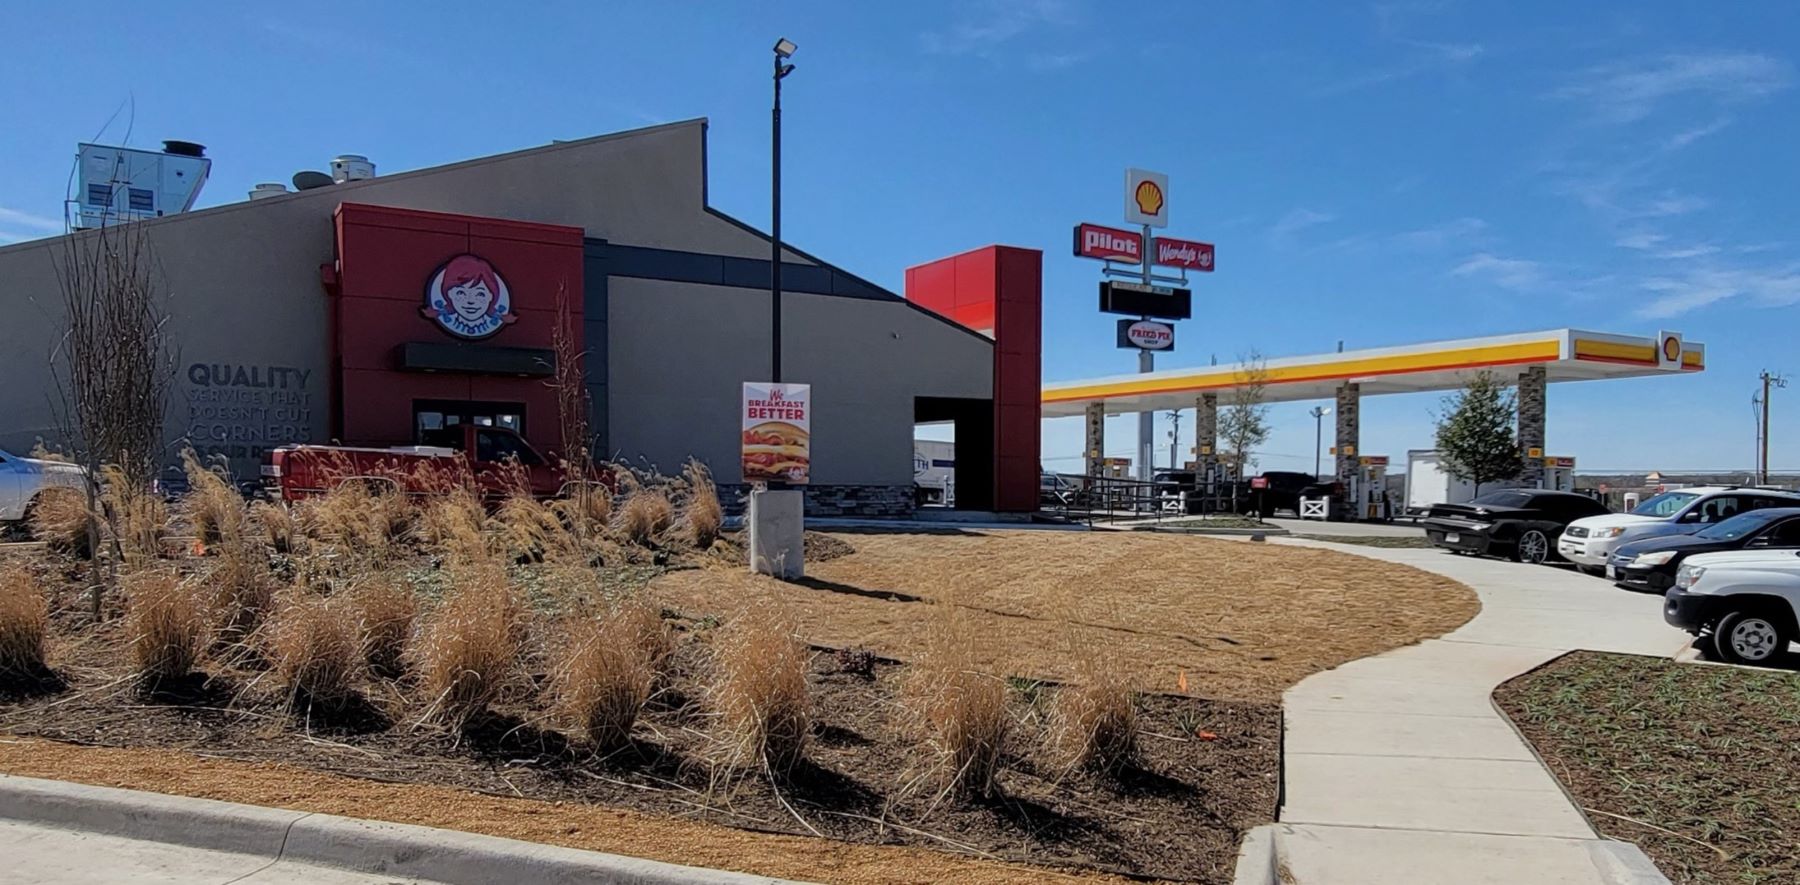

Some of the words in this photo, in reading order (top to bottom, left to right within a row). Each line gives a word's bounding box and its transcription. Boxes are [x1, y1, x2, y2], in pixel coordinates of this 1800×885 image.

[188, 363, 311, 389] QUALITY
[189, 388, 263, 405] SERVICE
[268, 390, 312, 406] THAT
[748, 400, 805, 408] BREAKFAST
[189, 405, 269, 421] DOESN'T
[275, 407, 311, 422] CUT
[748, 408, 805, 420] BETTER
[190, 423, 312, 443] CORNERS
